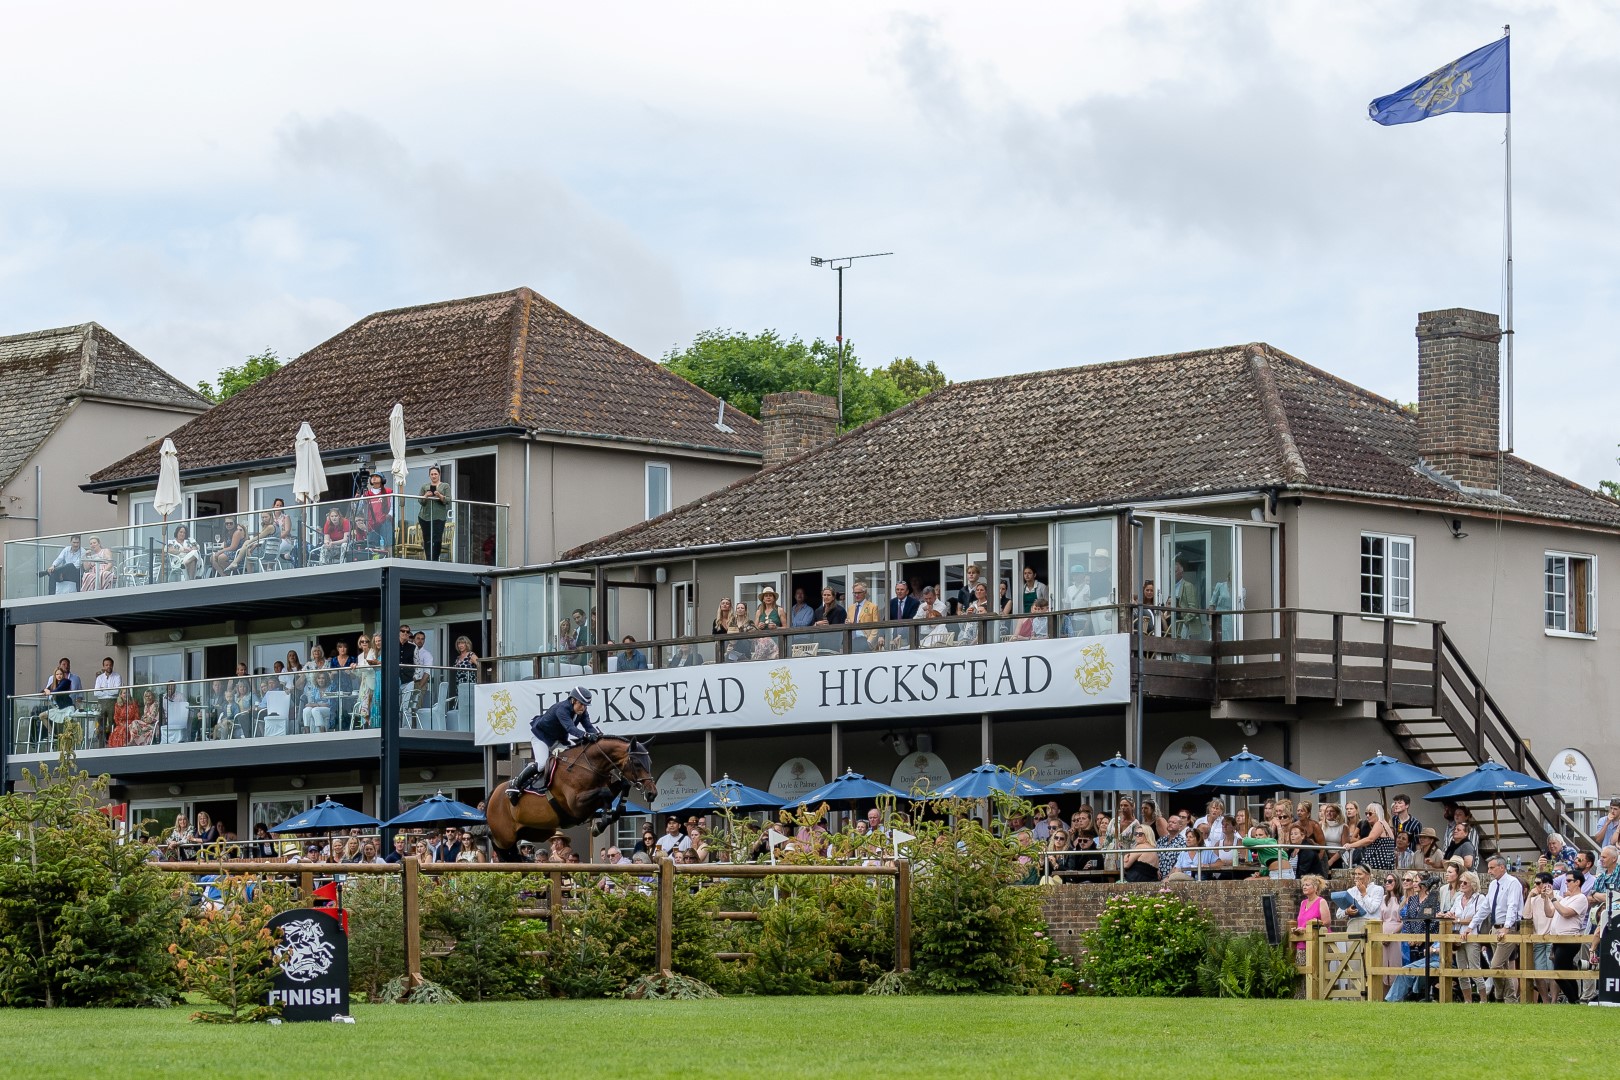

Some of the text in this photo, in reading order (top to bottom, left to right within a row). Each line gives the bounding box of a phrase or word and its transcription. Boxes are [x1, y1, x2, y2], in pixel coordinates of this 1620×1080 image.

[818, 655, 1052, 707] HICKSTEAD
[536, 677, 745, 724] HKSTEAD
[1166, 761, 1212, 771] Doyle & Palmer
[268, 988, 341, 1005] FINISH
